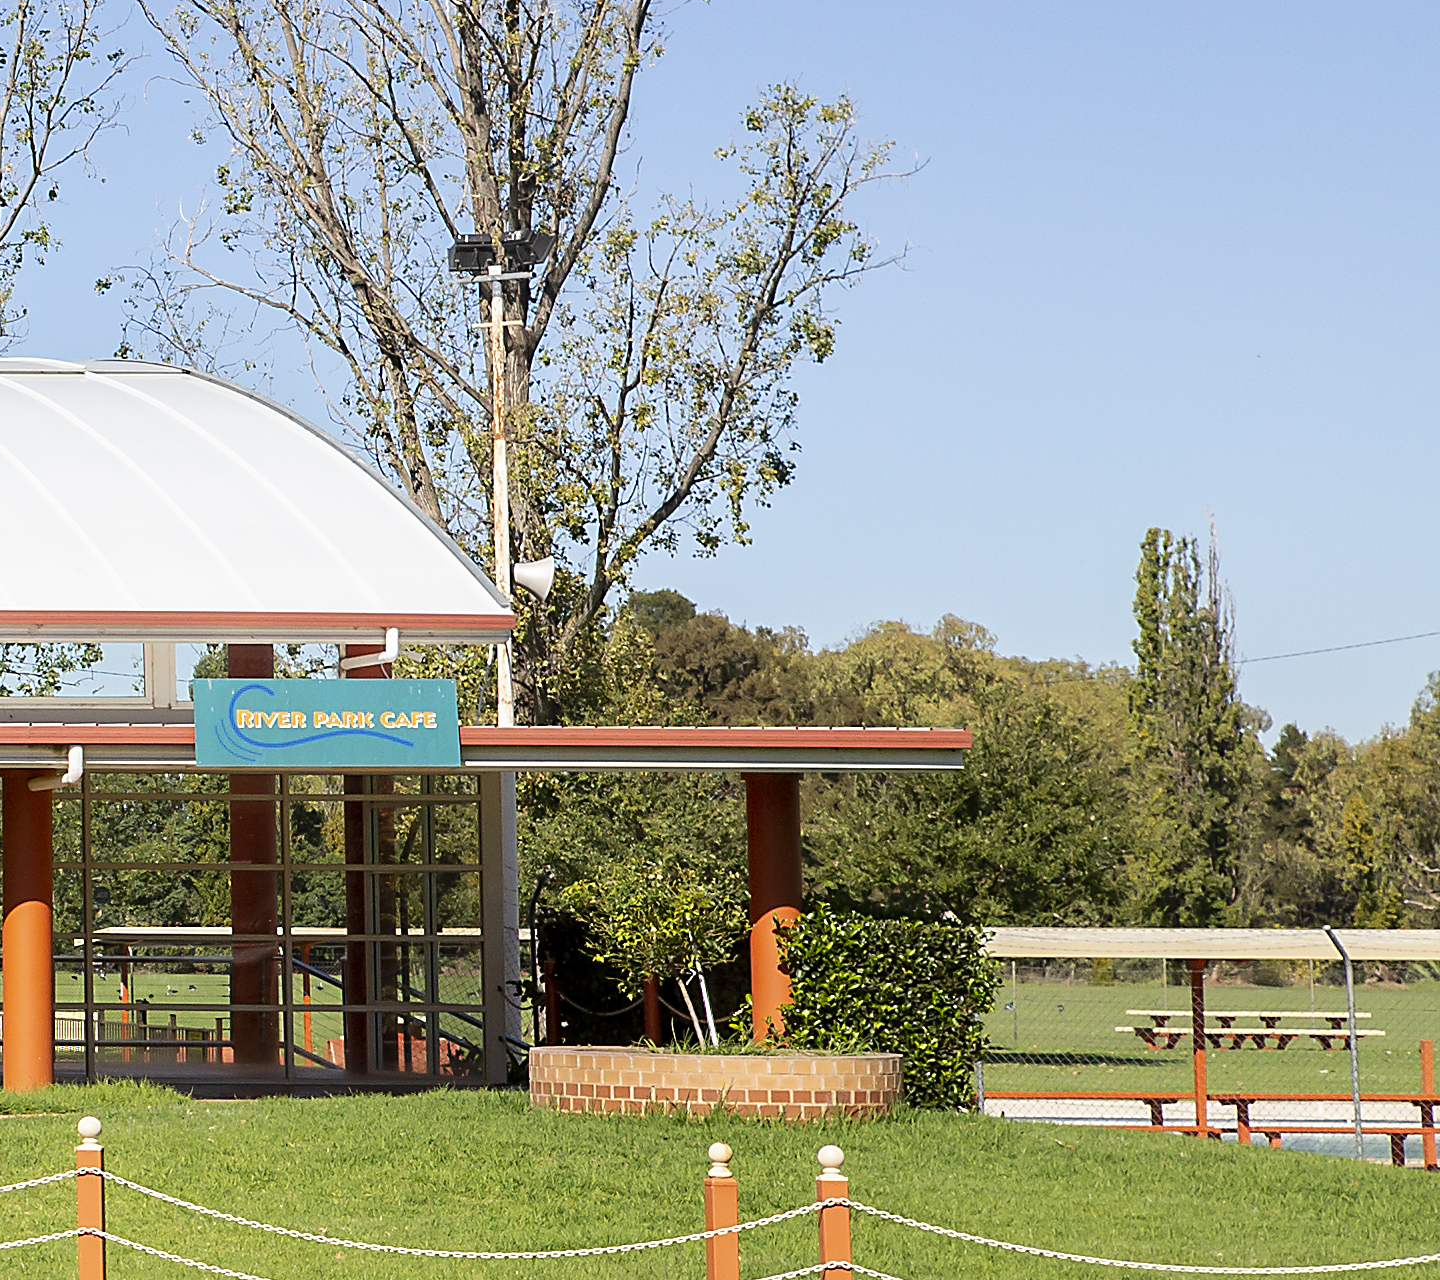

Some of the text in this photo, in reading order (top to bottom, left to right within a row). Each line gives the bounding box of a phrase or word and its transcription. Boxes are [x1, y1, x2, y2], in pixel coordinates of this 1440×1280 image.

[235, 709, 438, 729] RIVER PARK CAFE
